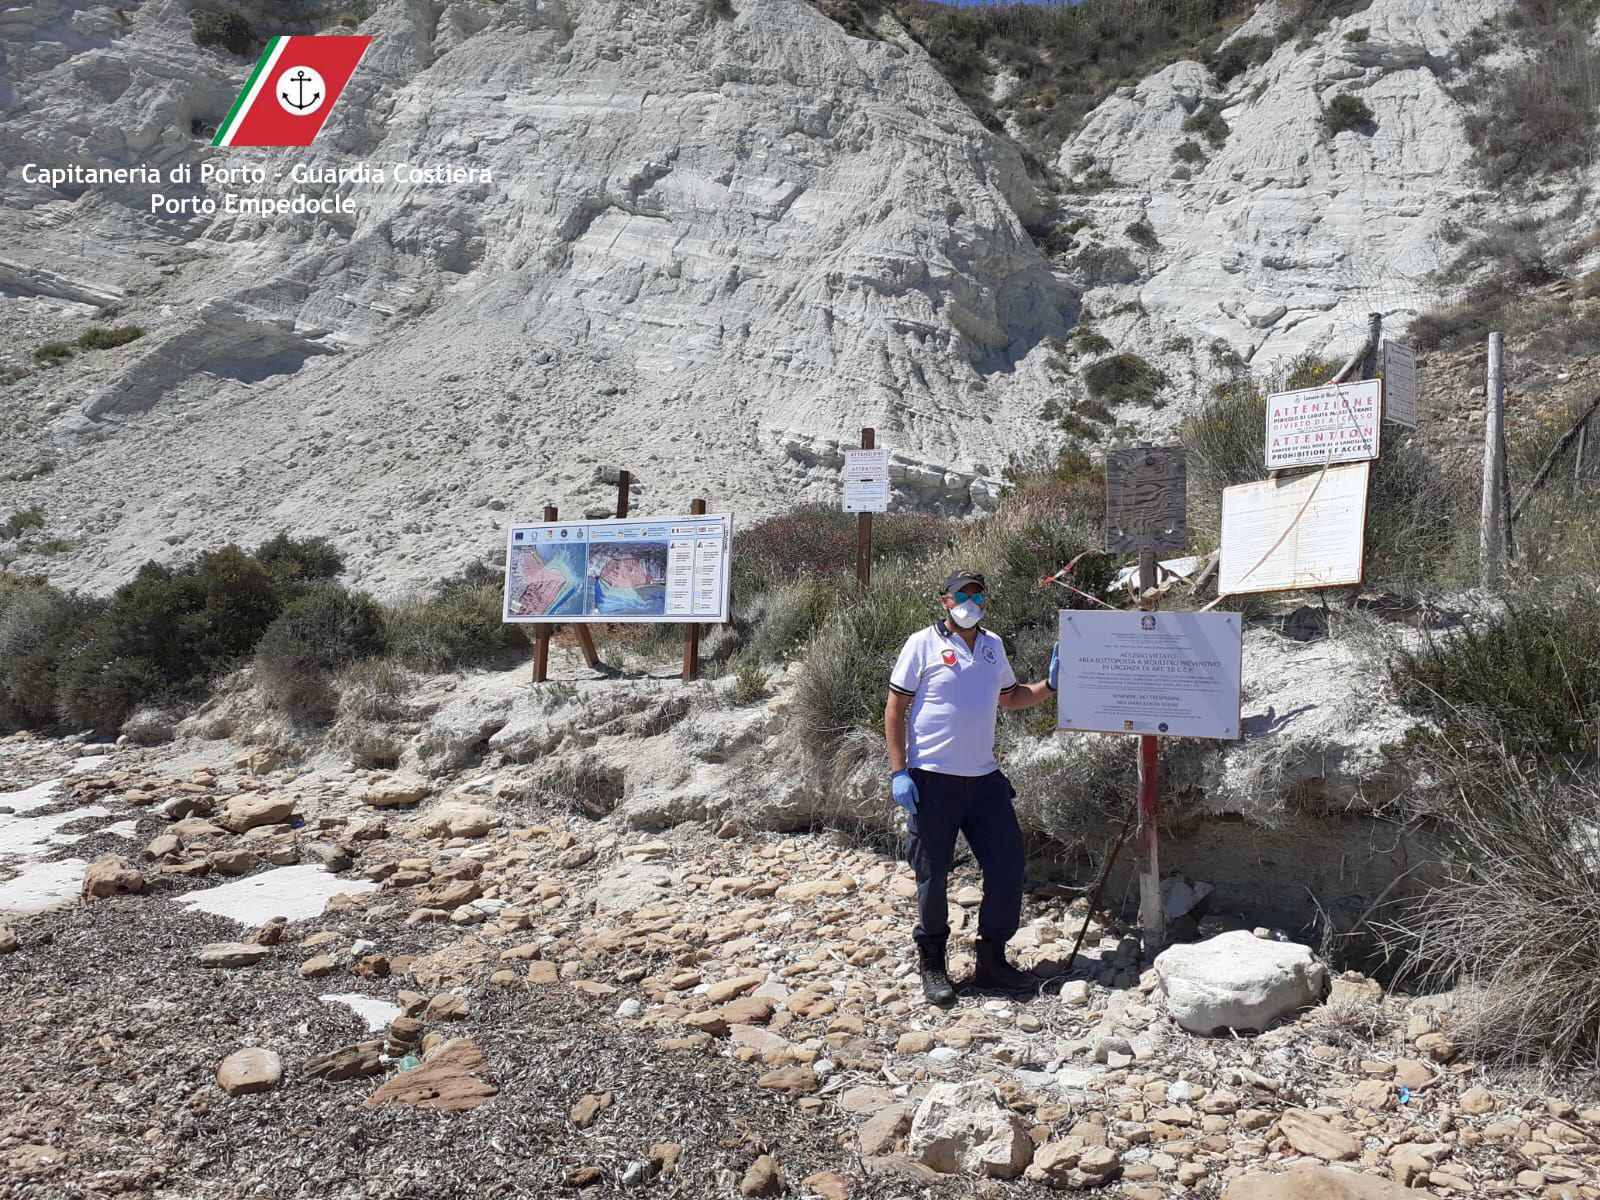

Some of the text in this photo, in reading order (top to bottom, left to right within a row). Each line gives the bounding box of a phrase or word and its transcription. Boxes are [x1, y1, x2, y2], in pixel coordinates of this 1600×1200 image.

[1274, 396, 1373, 418] ATTENZIONE
[1273, 415, 1299, 424] PERICOLO
[1308, 411, 1328, 419] CADUTA
[1273, 420, 1311, 431] DIVIETO
[1315, 418, 1325, 426] DI
[1328, 412, 1373, 424] ACESSO
[1272, 427, 1373, 447] ATTENTION
[1340, 438, 1373, 446] LANDSLIDES
[1272, 449, 1325, 460] PROHIBITION
[1341, 444, 1373, 453] ACCESS
[1096, 657, 1136, 665] SOTTOPOSTA
[1144, 659, 1179, 667] SEQUESTRO
[1179, 660, 1221, 668] PREVENTIVO
